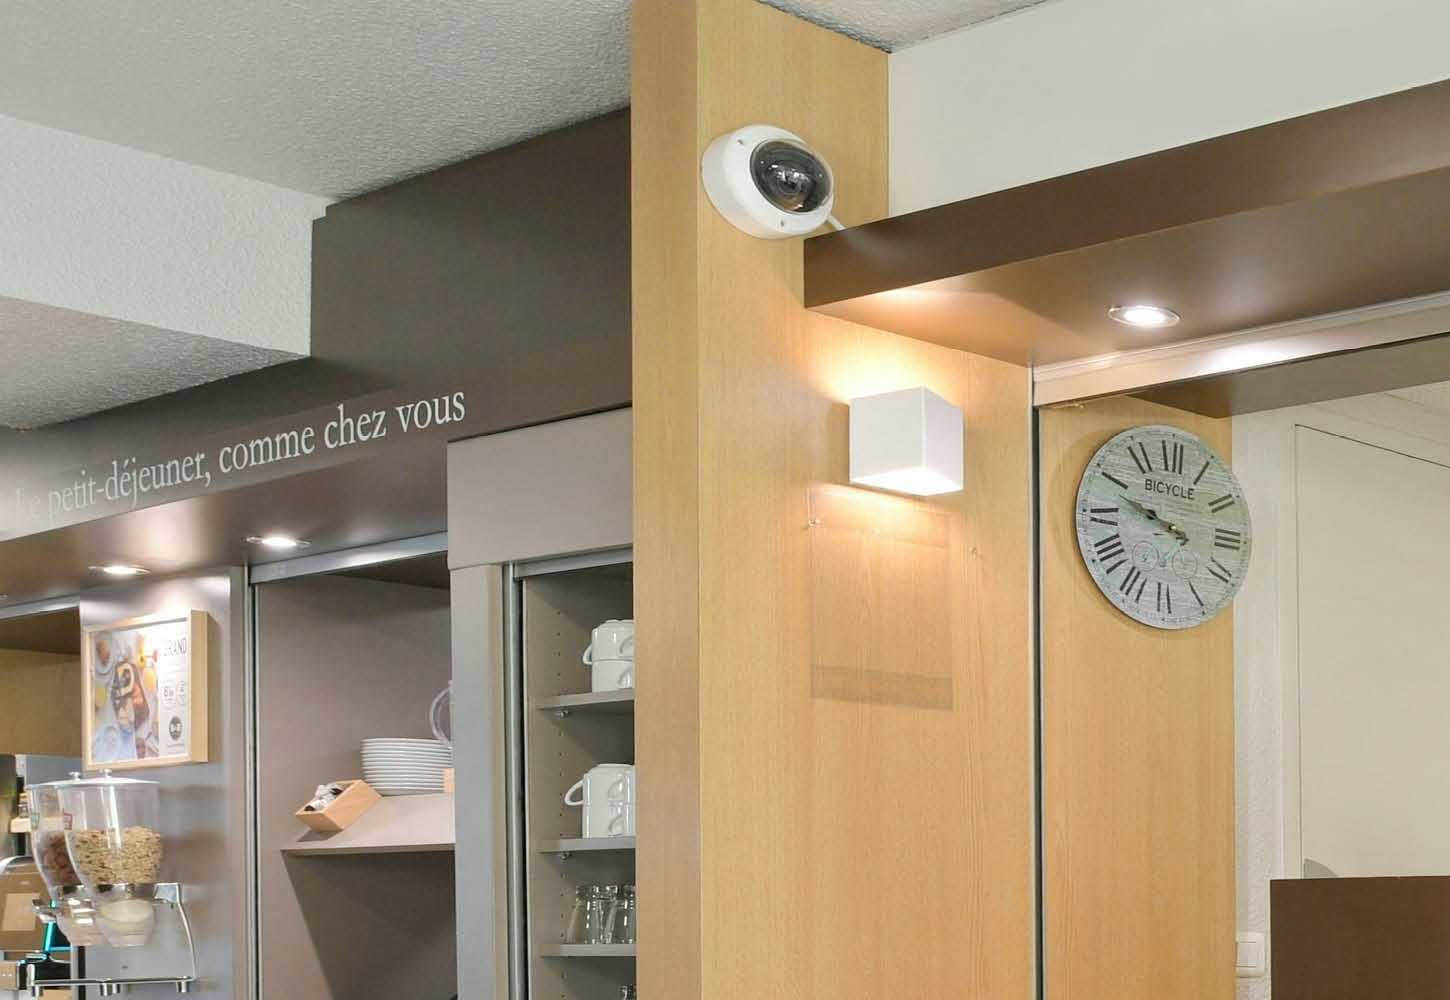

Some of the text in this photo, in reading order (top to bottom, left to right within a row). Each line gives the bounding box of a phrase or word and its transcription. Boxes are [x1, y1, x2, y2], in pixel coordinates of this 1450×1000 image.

[47, 452, 211, 525] petit-déjeuner,
[218, 426, 315, 474] comme
[324, 401, 387, 449] chez
[395, 391, 466, 434] vous
[1145, 478, 1195, 500] BICYCLE
